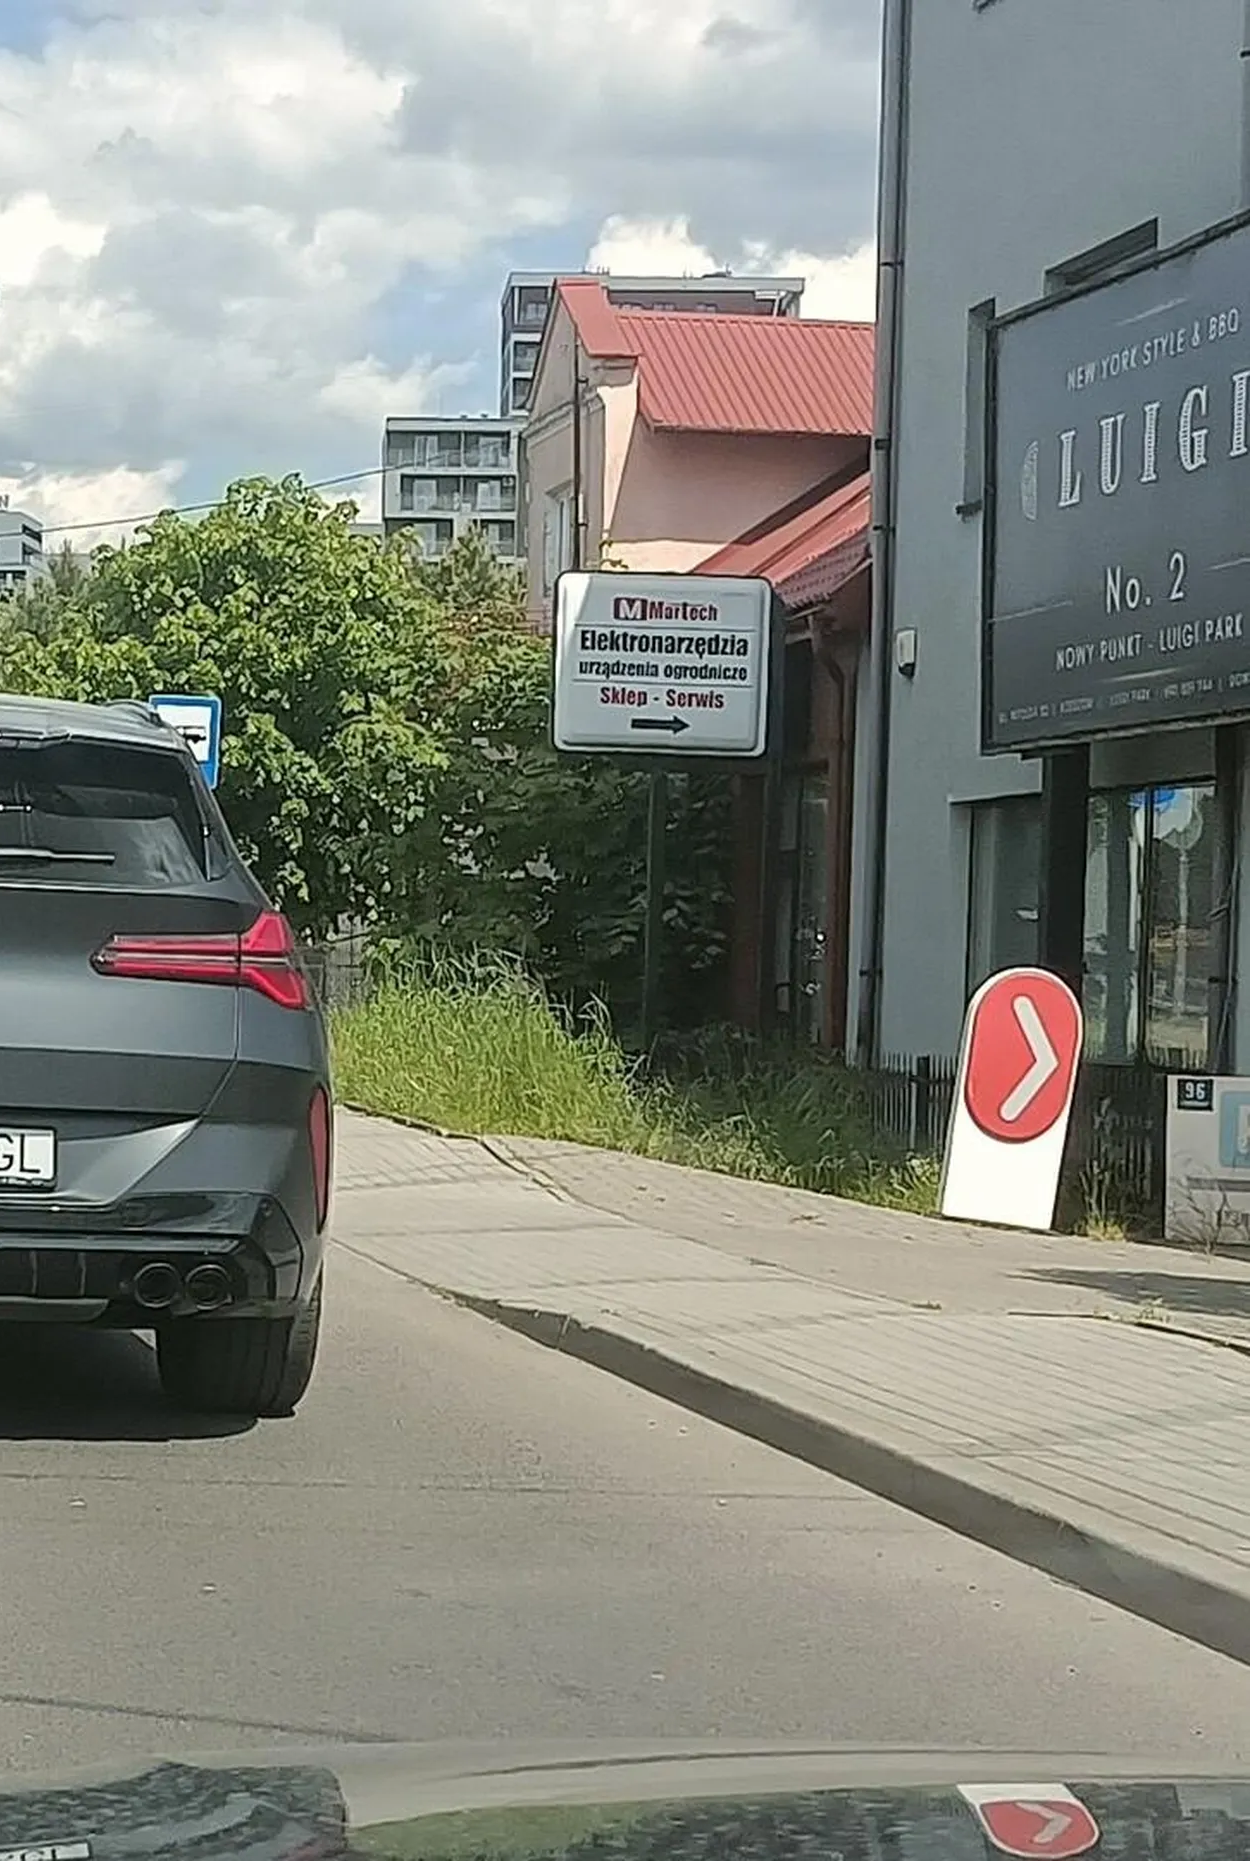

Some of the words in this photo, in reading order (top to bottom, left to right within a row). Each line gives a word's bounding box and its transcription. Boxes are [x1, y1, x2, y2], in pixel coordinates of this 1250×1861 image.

[1067, 363, 1096, 391] NEW
[1101, 346, 1139, 380] YORK
[1143, 327, 1188, 367] STYLE
[1192, 320, 1201, 347] &
[1057, 370, 1250, 507] LUIGI
[1105, 565, 1152, 614] No.
[1169, 551, 1185, 600] 2
[580, 630, 749, 659] Elektronarzędzia
[1055, 644, 1095, 671] NOWY
[1100, 633, 1142, 663] PUNKT
[1159, 619, 1200, 652] LUIGI
[1205, 611, 1244, 642] PARK
[579, 660, 659, 680] urządzenia
[664, 664, 748, 682] ogrodnicze
[600, 687, 647, 707] Sklep
[666, 689, 724, 709] Serwis
[1185, 1081, 1206, 1100] 96
